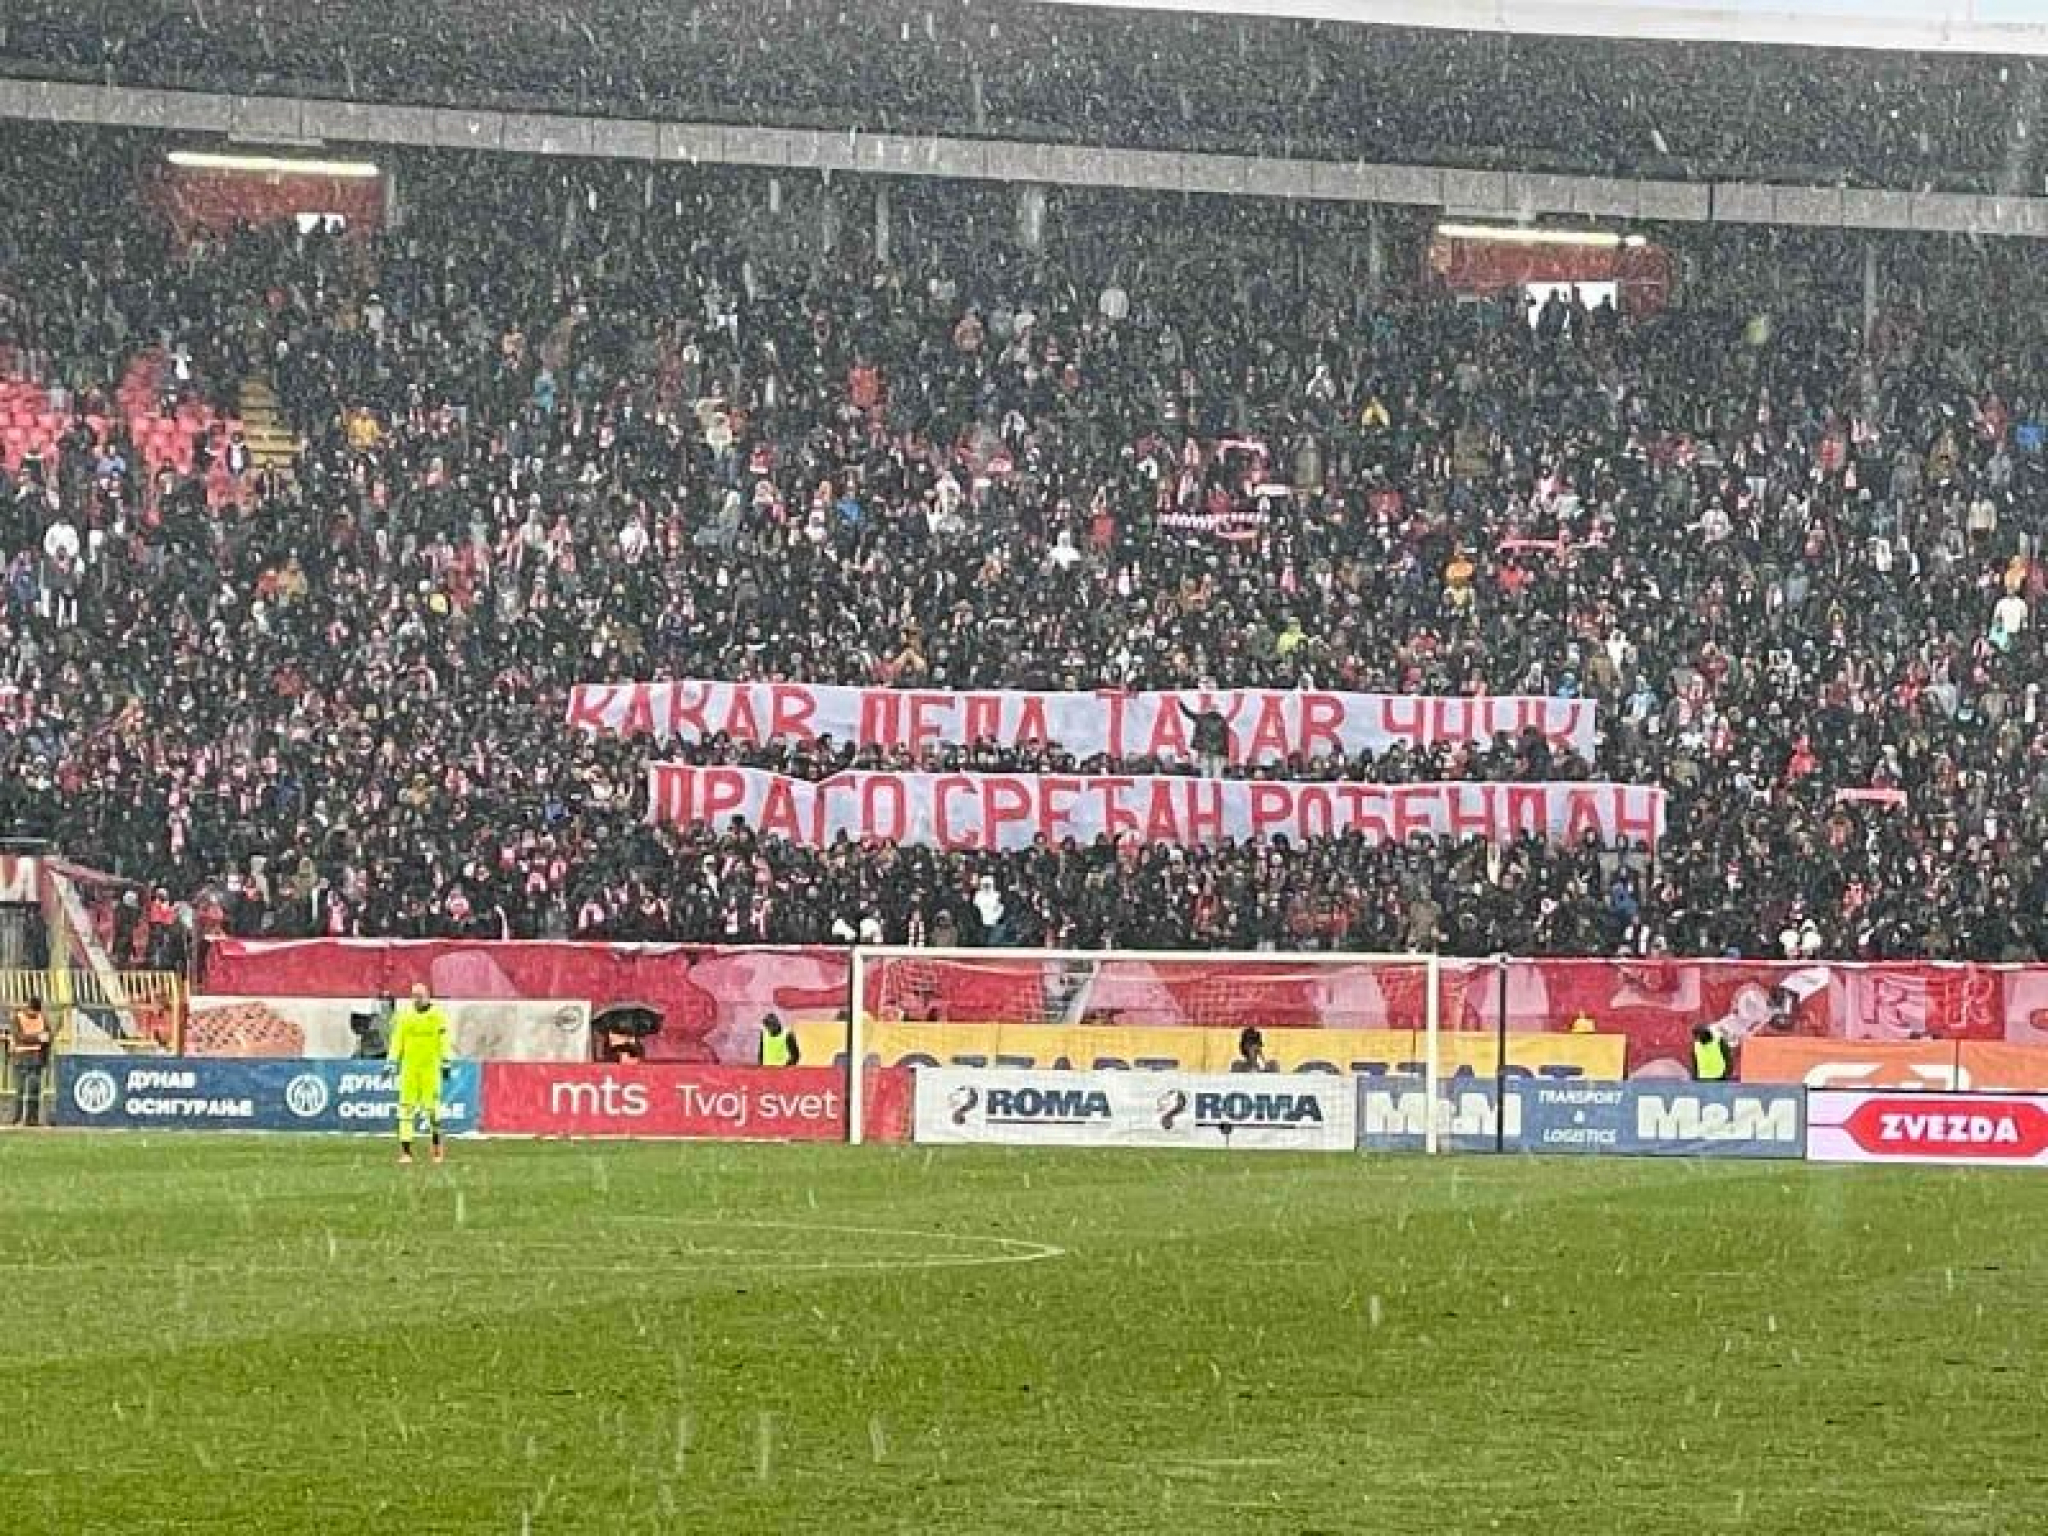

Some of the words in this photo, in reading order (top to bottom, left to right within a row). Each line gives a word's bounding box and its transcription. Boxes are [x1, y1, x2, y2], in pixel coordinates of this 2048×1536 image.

[569, 683, 818, 750] КАКАВ
[1095, 685, 1345, 768] ТАКАВ
[126, 1071, 196, 1091] ДУНАВ
[337, 1073, 397, 1094] ДУНА
[551, 1074, 649, 1117] mts
[1538, 1088, 1624, 1104] TRANSPORT
[124, 1099, 254, 1117] ОСИГУРАЊЕ
[675, 1084, 748, 1127] Tvoj
[757, 1089, 839, 1120] svet
[986, 1088, 1112, 1118] ROMA
[1195, 1092, 1324, 1122] ROMA
[1636, 1096, 1797, 1141] M&M
[1879, 1112, 2020, 1144] ZVEZDA
[1542, 1127, 1618, 1145] LOGISTICS
